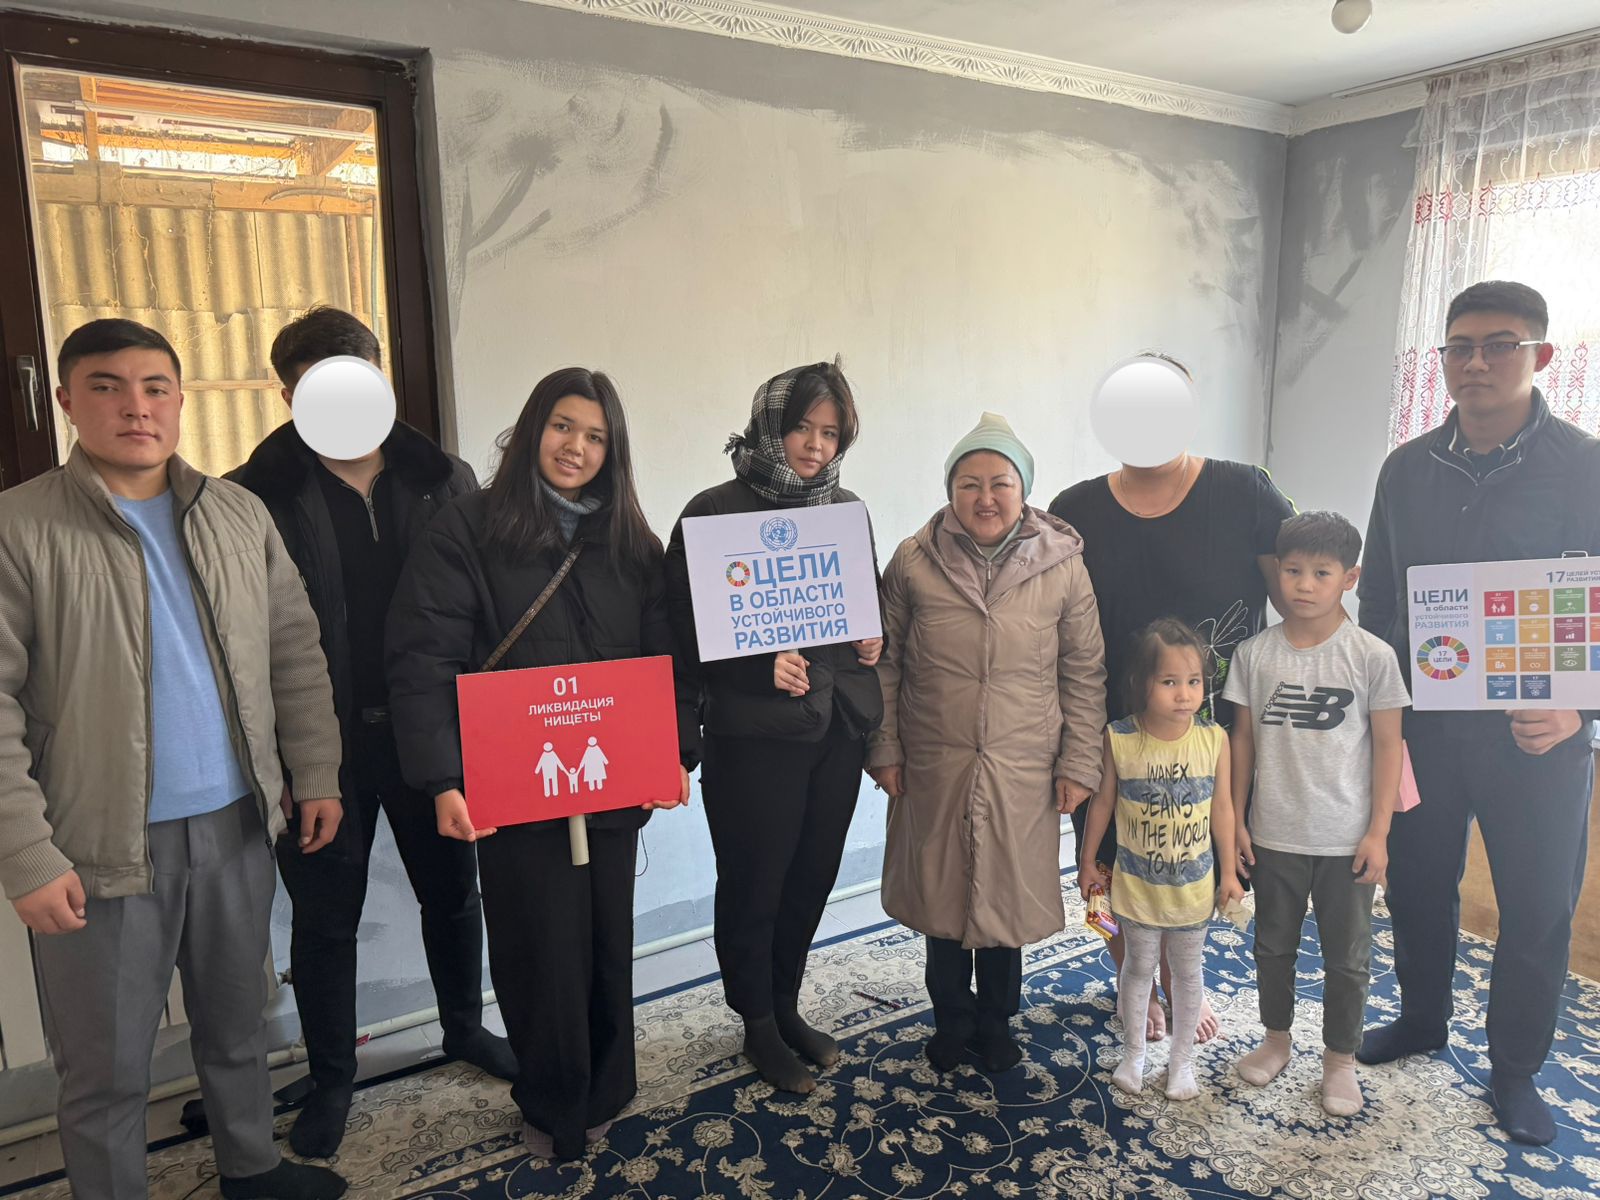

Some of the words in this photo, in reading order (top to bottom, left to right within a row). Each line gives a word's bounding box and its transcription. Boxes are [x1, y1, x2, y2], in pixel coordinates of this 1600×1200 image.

[752, 551, 841, 588] ЦЕЛИ
[1546, 571, 1565, 583] 17
[729, 594, 744, 612] В
[750, 582, 844, 609] ОБЛАСТИ
[1413, 589, 1468, 606] ЦЕЛИ
[731, 603, 846, 629] УСТОЙЧИВОГО
[1415, 612, 1468, 621] устойчивого
[1433, 604, 1468, 612] области
[735, 618, 848, 650] РАЗВИТИЯ
[1415, 620, 1469, 629] РАЗВИТИЯ
[553, 676, 578, 696] 01
[528, 697, 614, 716] ЛИКВИДАЦИЯ
[544, 711, 601, 727] НИЩЕТЫ
[1141, 792, 1193, 819] JEANS
[1128, 816, 1138, 840] IN
[1141, 820, 1167, 848] THE
[1172, 816, 1208, 849] WORLD
[1146, 850, 1164, 875] TO
